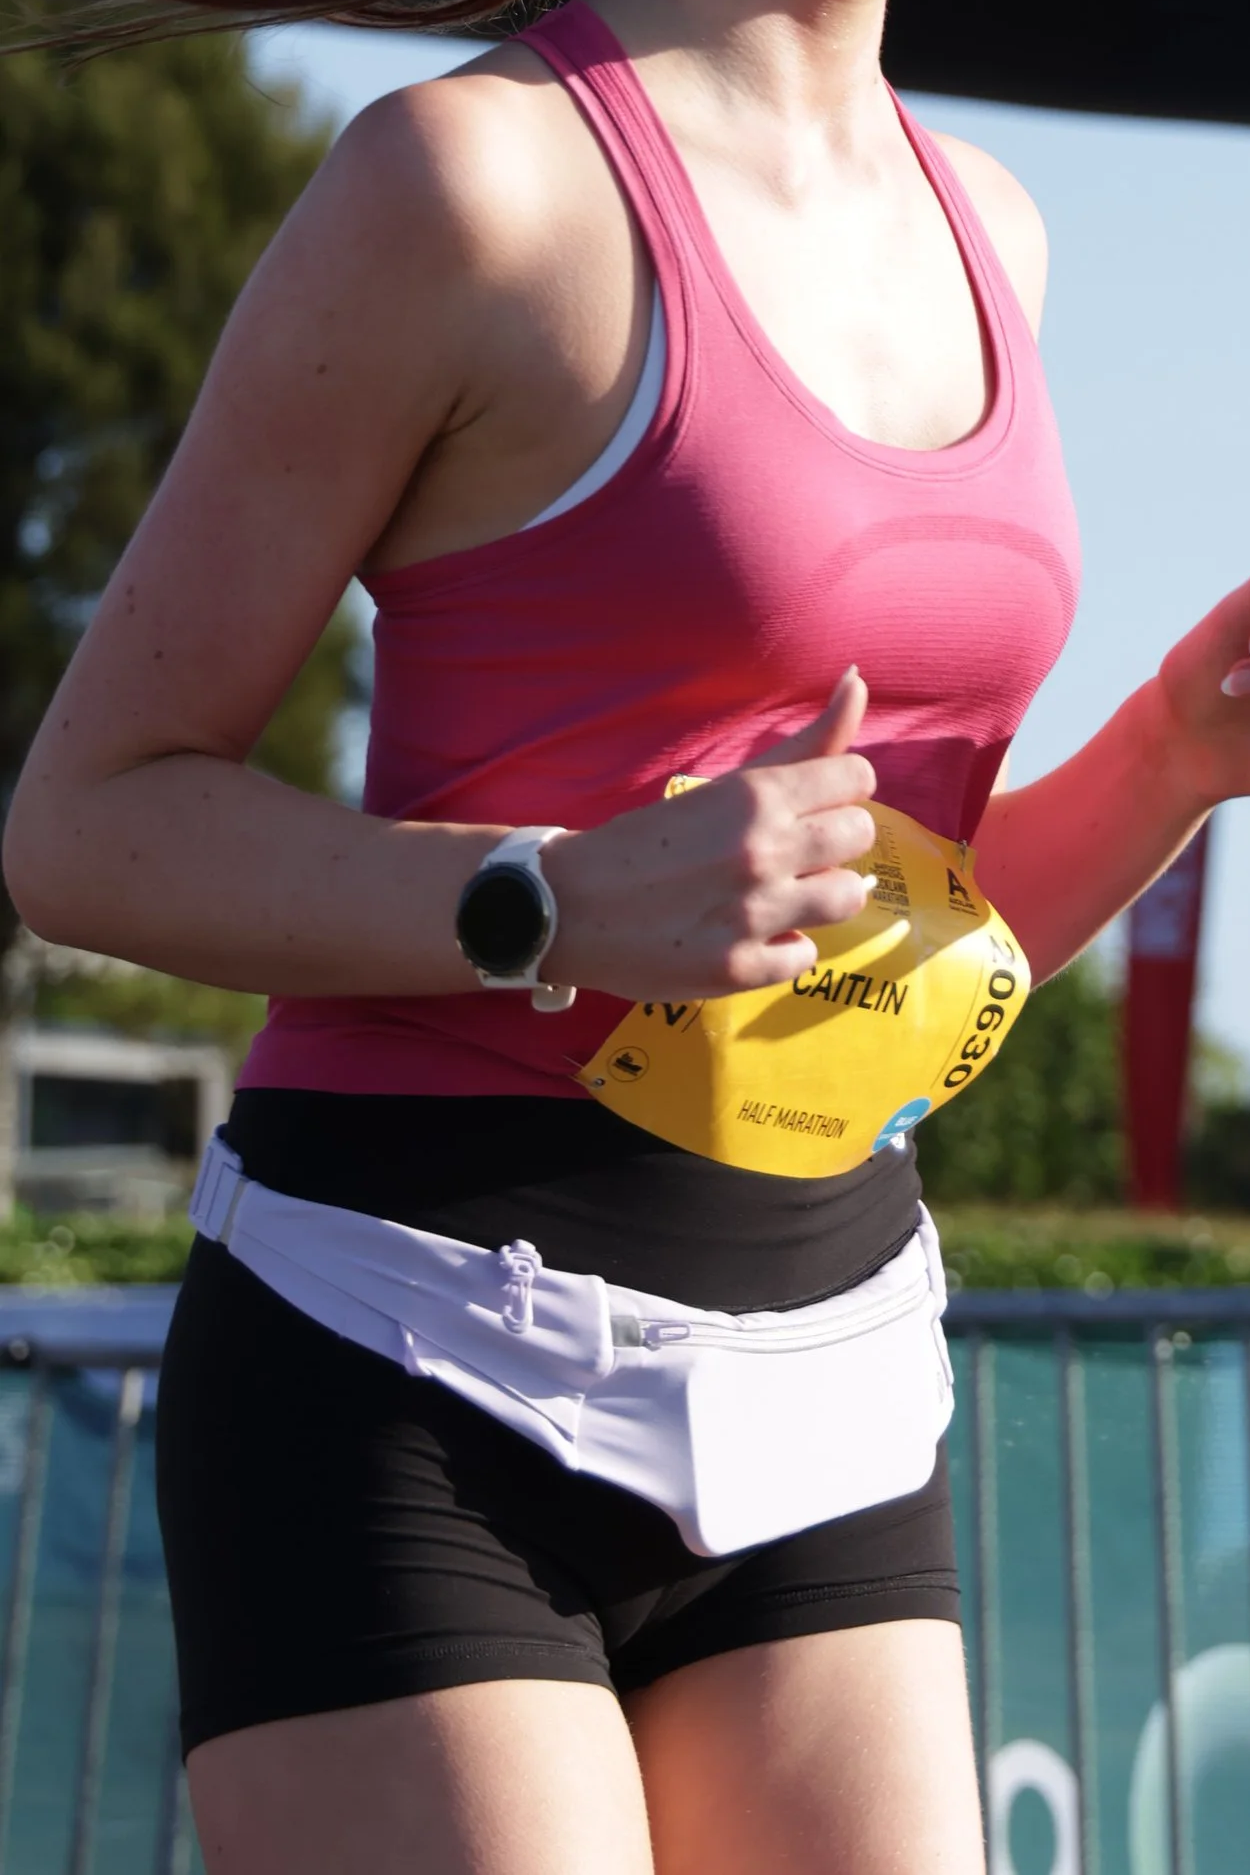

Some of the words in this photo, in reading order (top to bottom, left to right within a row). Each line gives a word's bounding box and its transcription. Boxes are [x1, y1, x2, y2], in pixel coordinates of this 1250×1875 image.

[792, 963, 909, 1016] CAITLIN
[943, 934, 1017, 1089] 20630
[736, 1099, 777, 1126] HALF
[772, 1106, 850, 1140] MARATHON
